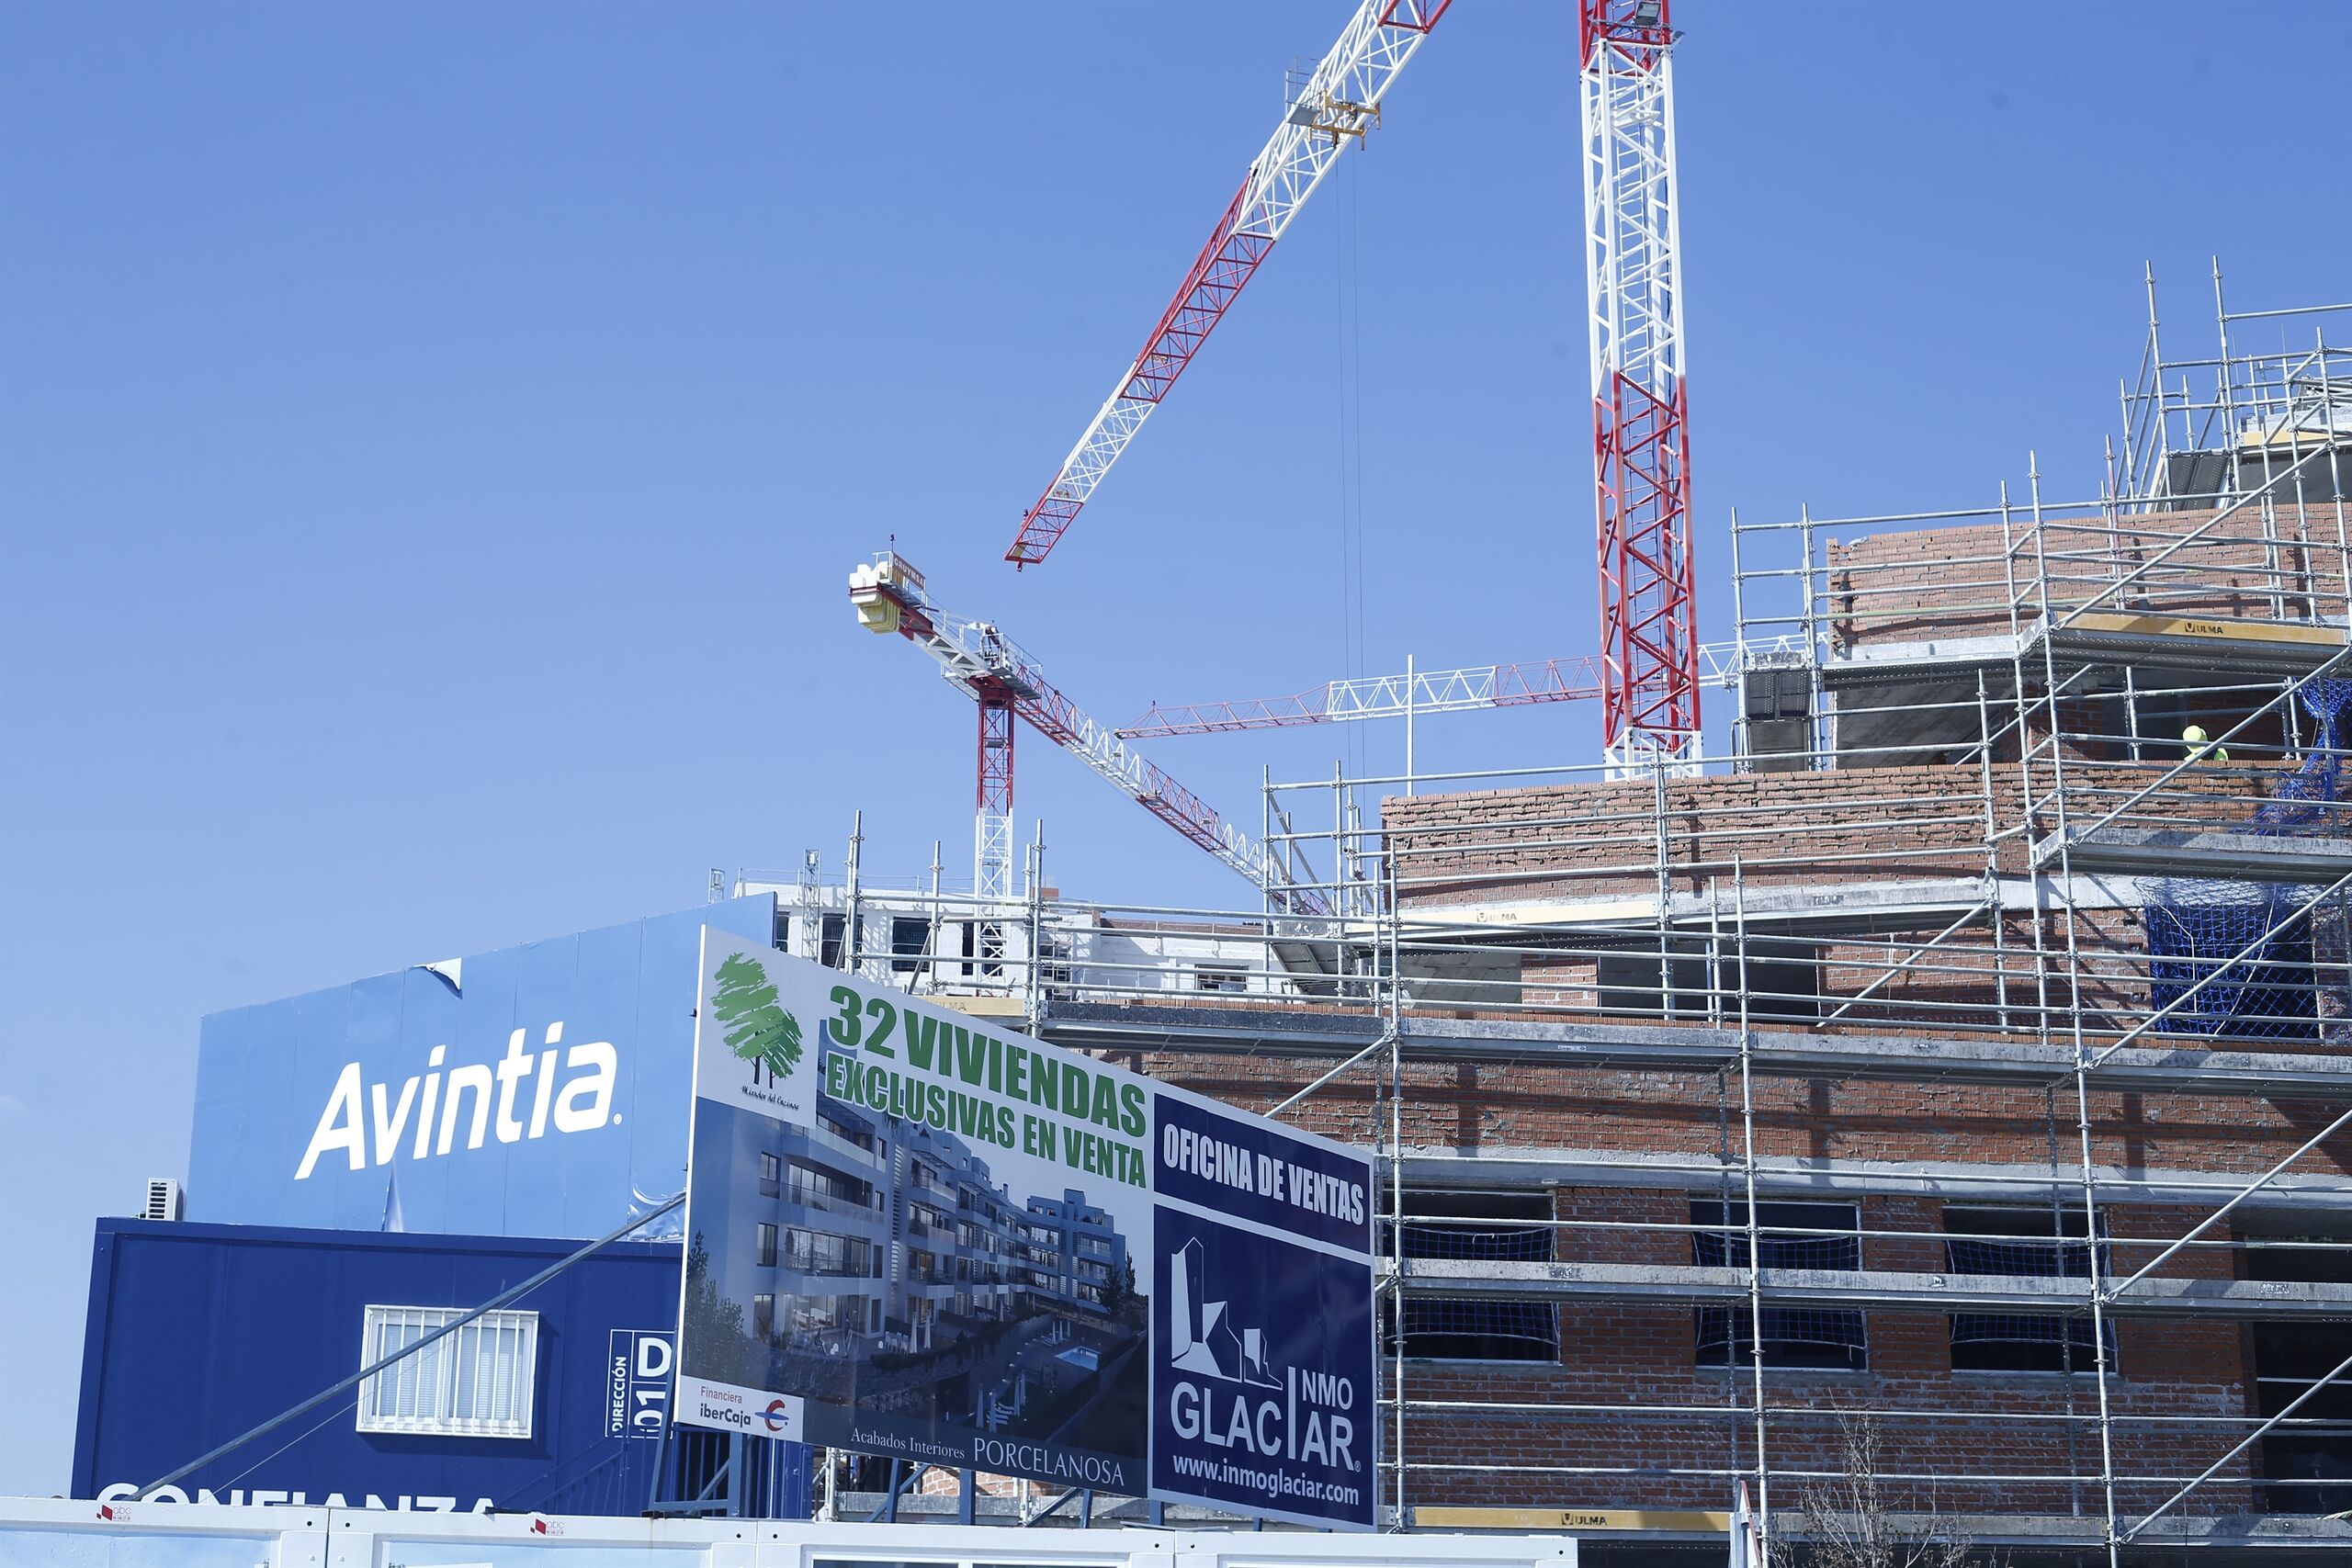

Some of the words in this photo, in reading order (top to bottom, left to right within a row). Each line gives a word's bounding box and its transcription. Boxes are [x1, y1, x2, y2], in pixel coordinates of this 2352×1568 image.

[2196, 625, 2223, 634] ULMA
[829, 985, 897, 1059] 32
[904, 1009, 1147, 1137] VIVIENDAS
[294, 1021, 617, 1180] Avintia
[827, 1054, 1015, 1149] EXCLUSIVAS
[1023, 1113, 1056, 1162] EN
[1063, 1126, 1147, 1189] VENTA
[1163, 1123, 1253, 1192] OFICINA
[1258, 1154, 1283, 1201] DE
[1288, 1163, 1364, 1225] VENTAS
[612, 1357, 627, 1432] DIRECCIÓN
[700, 1386, 742, 1404] Financiera
[700, 1404, 751, 1427] iberCaja
[851, 1427, 906, 1450] Acabados
[910, 1437, 965, 1460] Interiores
[974, 1438, 1125, 1486] PORCELANOSA
[1172, 1455, 1360, 1506] www.inmoglaciar.com
[1576, 1516, 1607, 1526] ULMA
